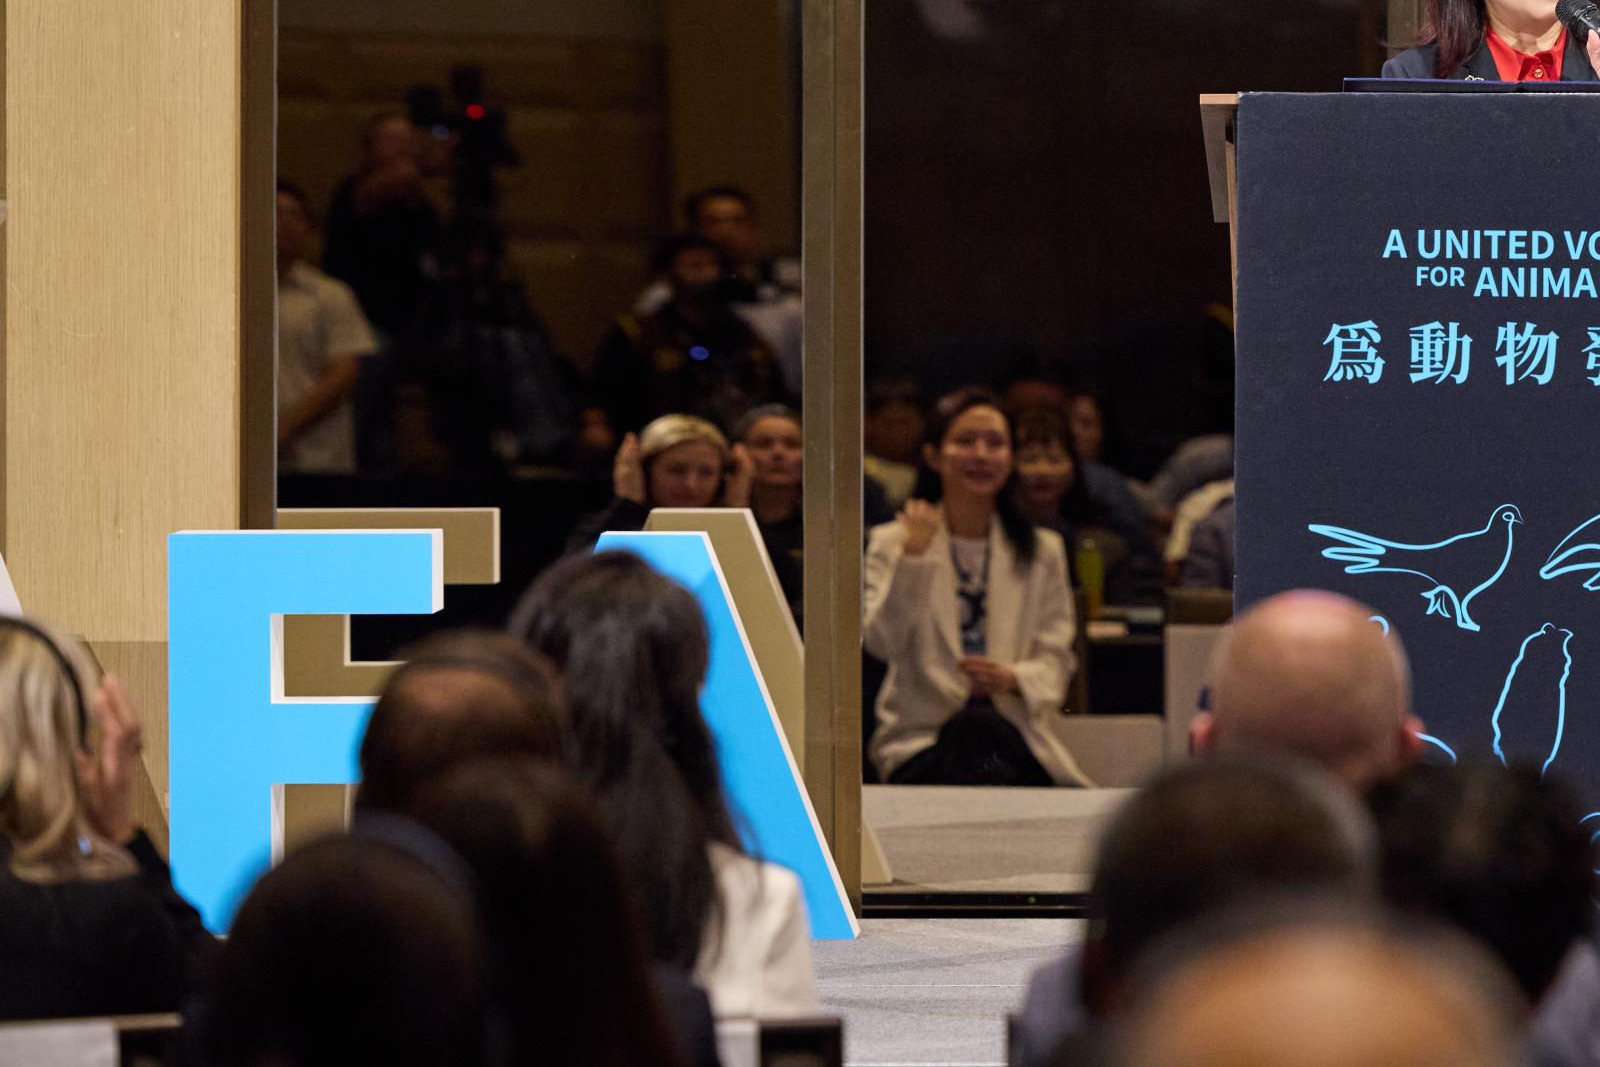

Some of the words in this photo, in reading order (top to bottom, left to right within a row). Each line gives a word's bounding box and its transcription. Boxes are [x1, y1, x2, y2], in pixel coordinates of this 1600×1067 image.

[1382, 228, 1408, 259] A
[1417, 229, 1555, 260] UNITED
[1416, 266, 1465, 287] FOR
